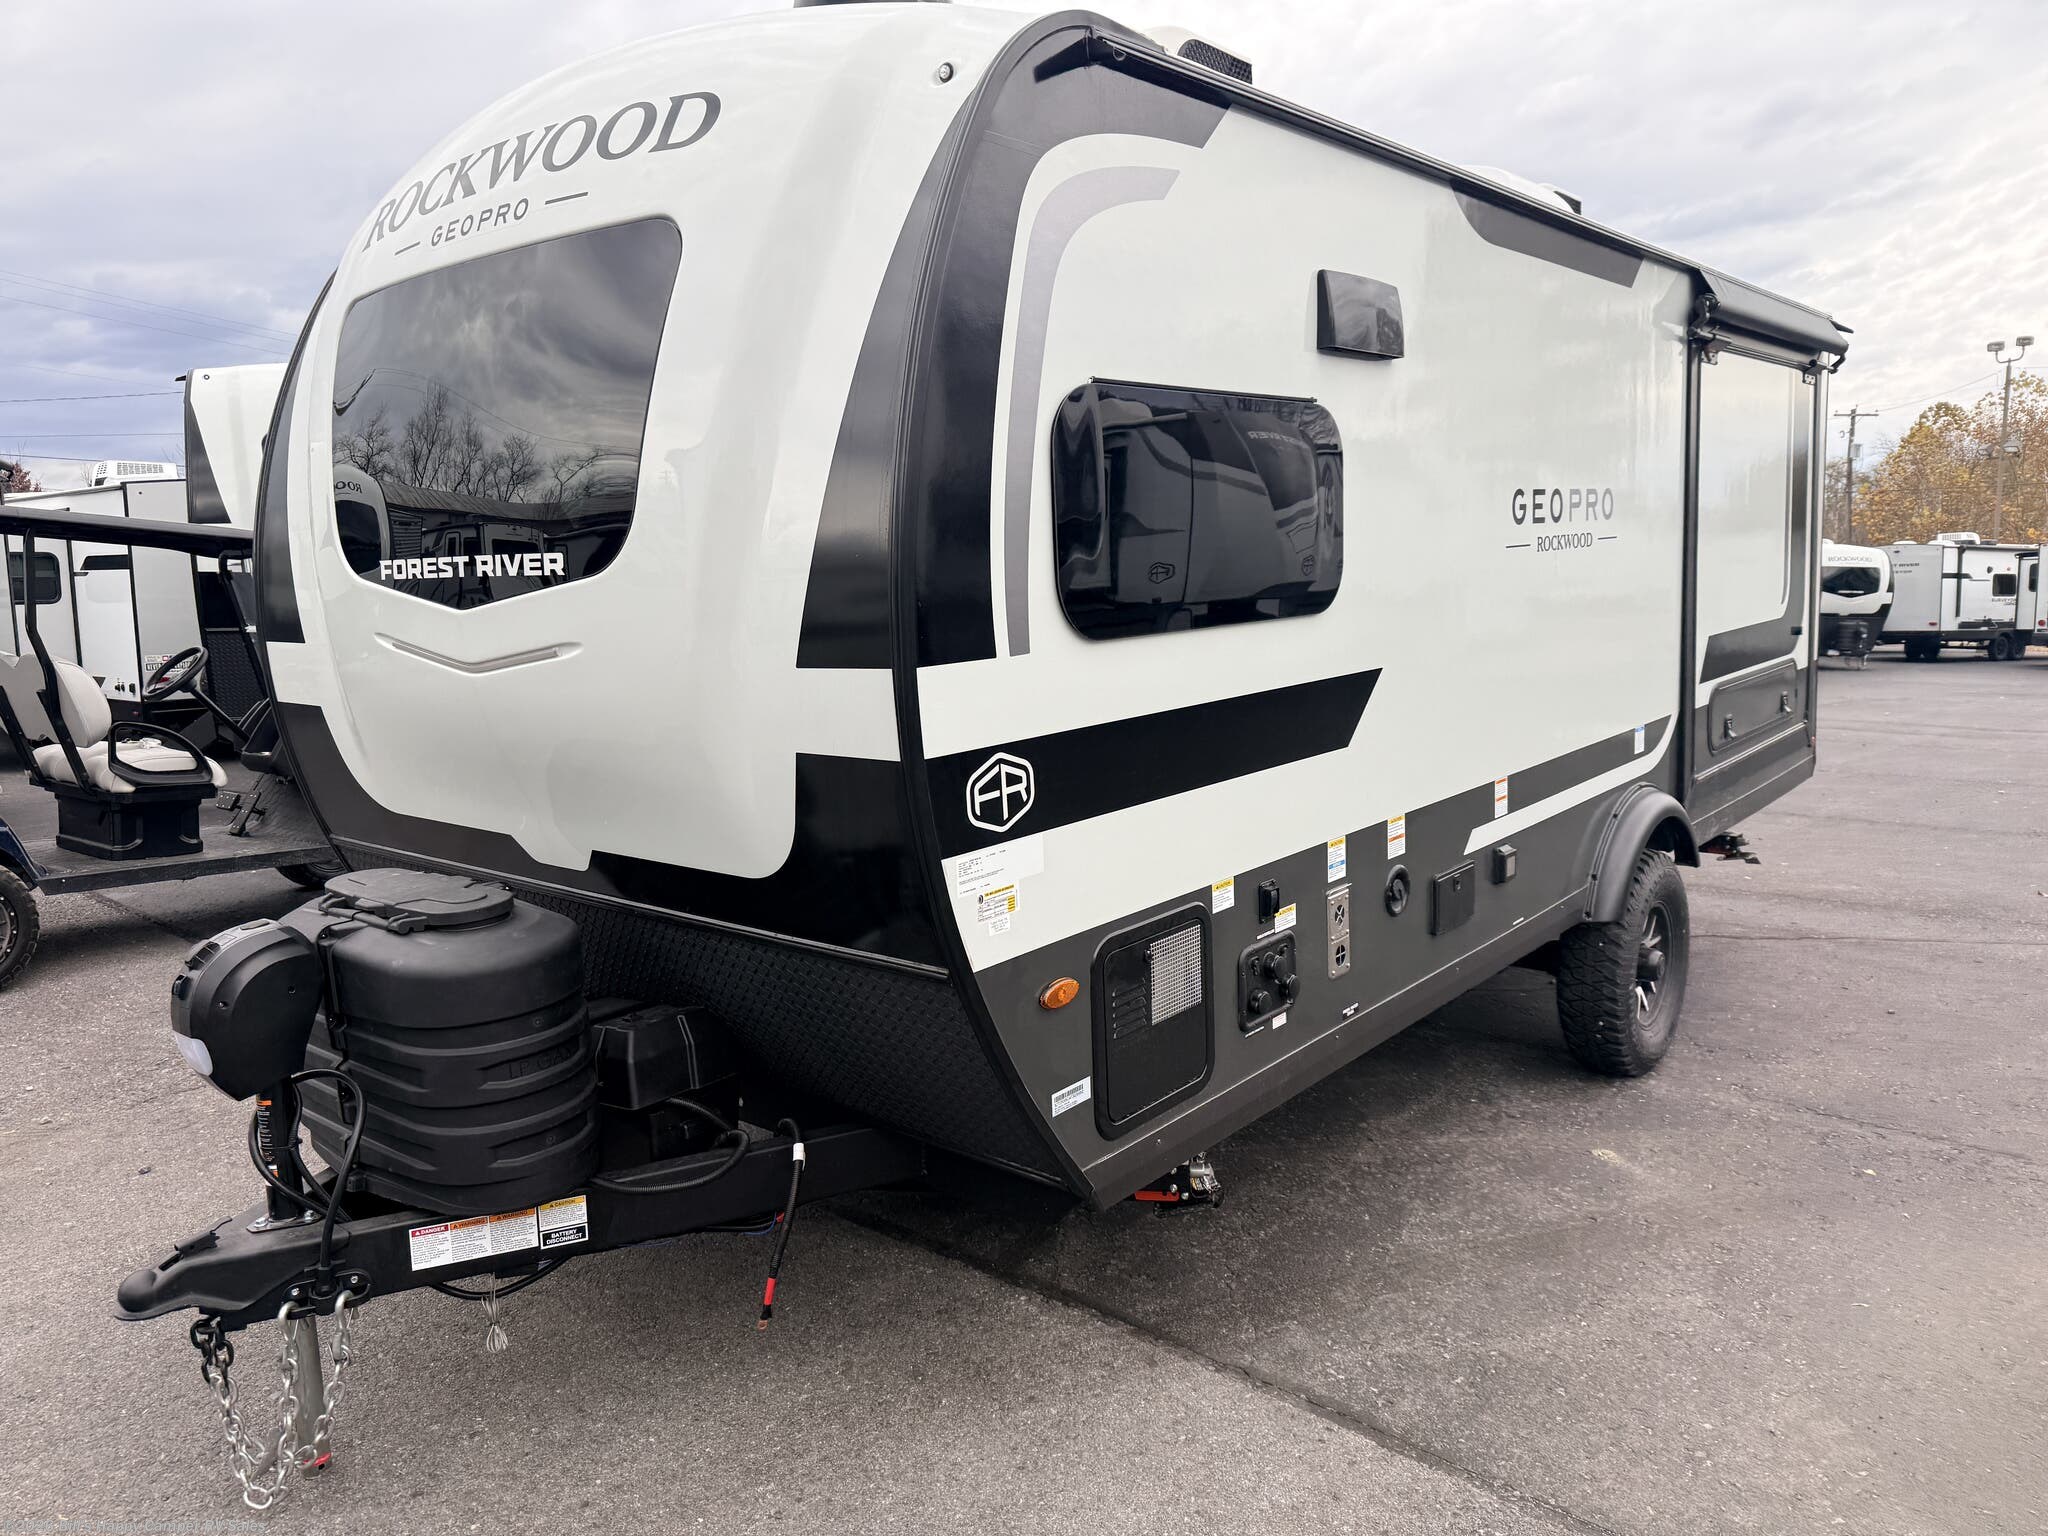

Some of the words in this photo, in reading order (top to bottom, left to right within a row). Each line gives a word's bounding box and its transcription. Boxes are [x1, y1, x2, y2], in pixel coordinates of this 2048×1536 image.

[361, 91, 722, 252] ROCKWOOD
[430, 198, 529, 247] GEOPRO
[1511, 487, 1614, 525] GEOPRO
[1536, 532, 1593, 552] ROCKWOOD
[379, 556, 469, 580] FOREST
[474, 552, 565, 578] RIVER
[420, 1226, 446, 1235] DANGER
[546, 1232, 583, 1245] DISCONNECT
[551, 1229, 577, 1238] BATTERY
